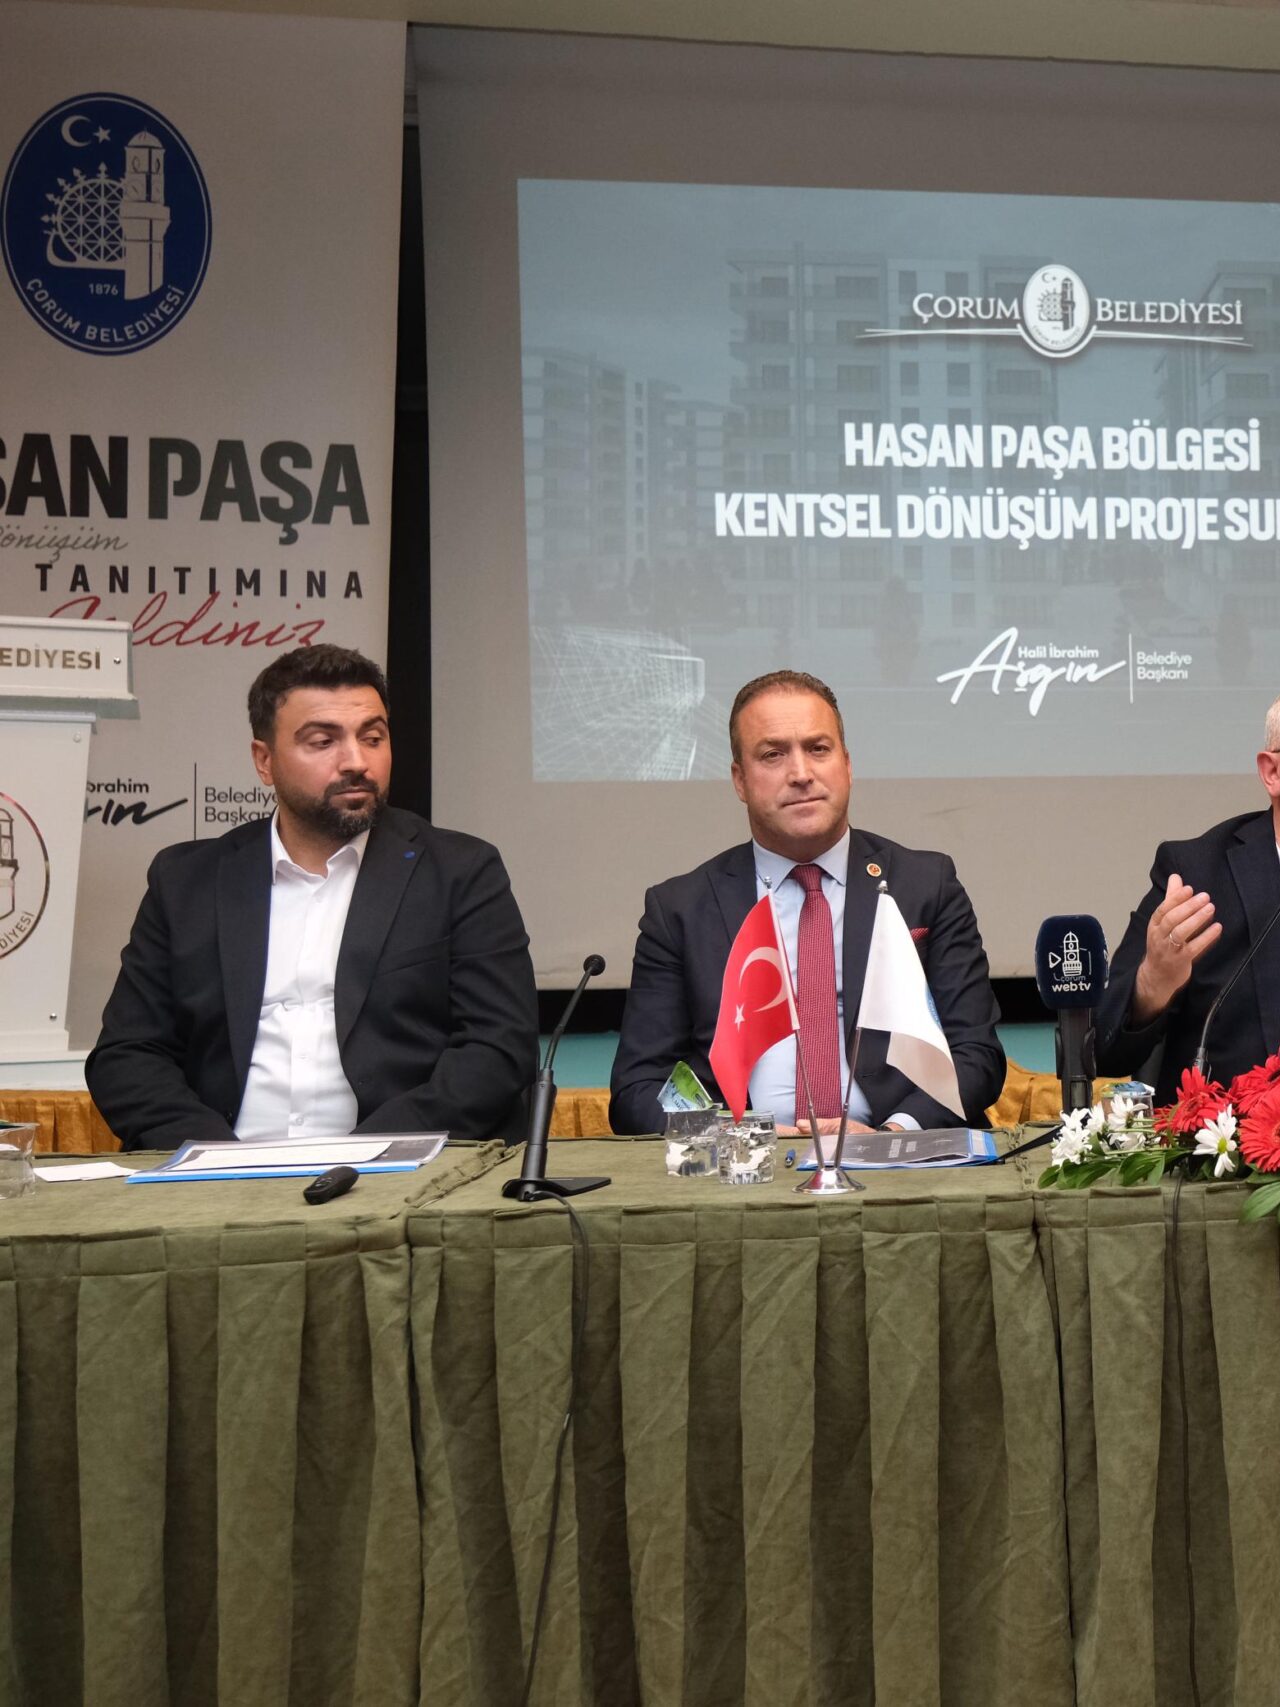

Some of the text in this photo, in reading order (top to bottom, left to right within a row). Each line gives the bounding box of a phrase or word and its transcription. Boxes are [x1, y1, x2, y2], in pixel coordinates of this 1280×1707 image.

[89, 283, 118, 296] 1876
[26, 278, 185, 342] ÇORUM BELEDİYESİ
[912, 292, 1243, 325] ÇORUM BELEDİYESİ
[844, 419, 1261, 479] HASAN PAŞA BÖLGESİ
[0, 433, 370, 545] AN PAŞA
[714, 493, 891, 538] KENTSEL
[898, 487, 1097, 550] DÖNÜŞÜM
[1105, 497, 1219, 549] PROJE
[0, 524, 128, 563] önüşüm
[35, 563, 363, 599] TANITIMINA
[1018, 643, 1099, 659] Halil İbrahim
[1136, 652, 1193, 667] Belediye
[1136, 667, 1189, 682] Başkanı
